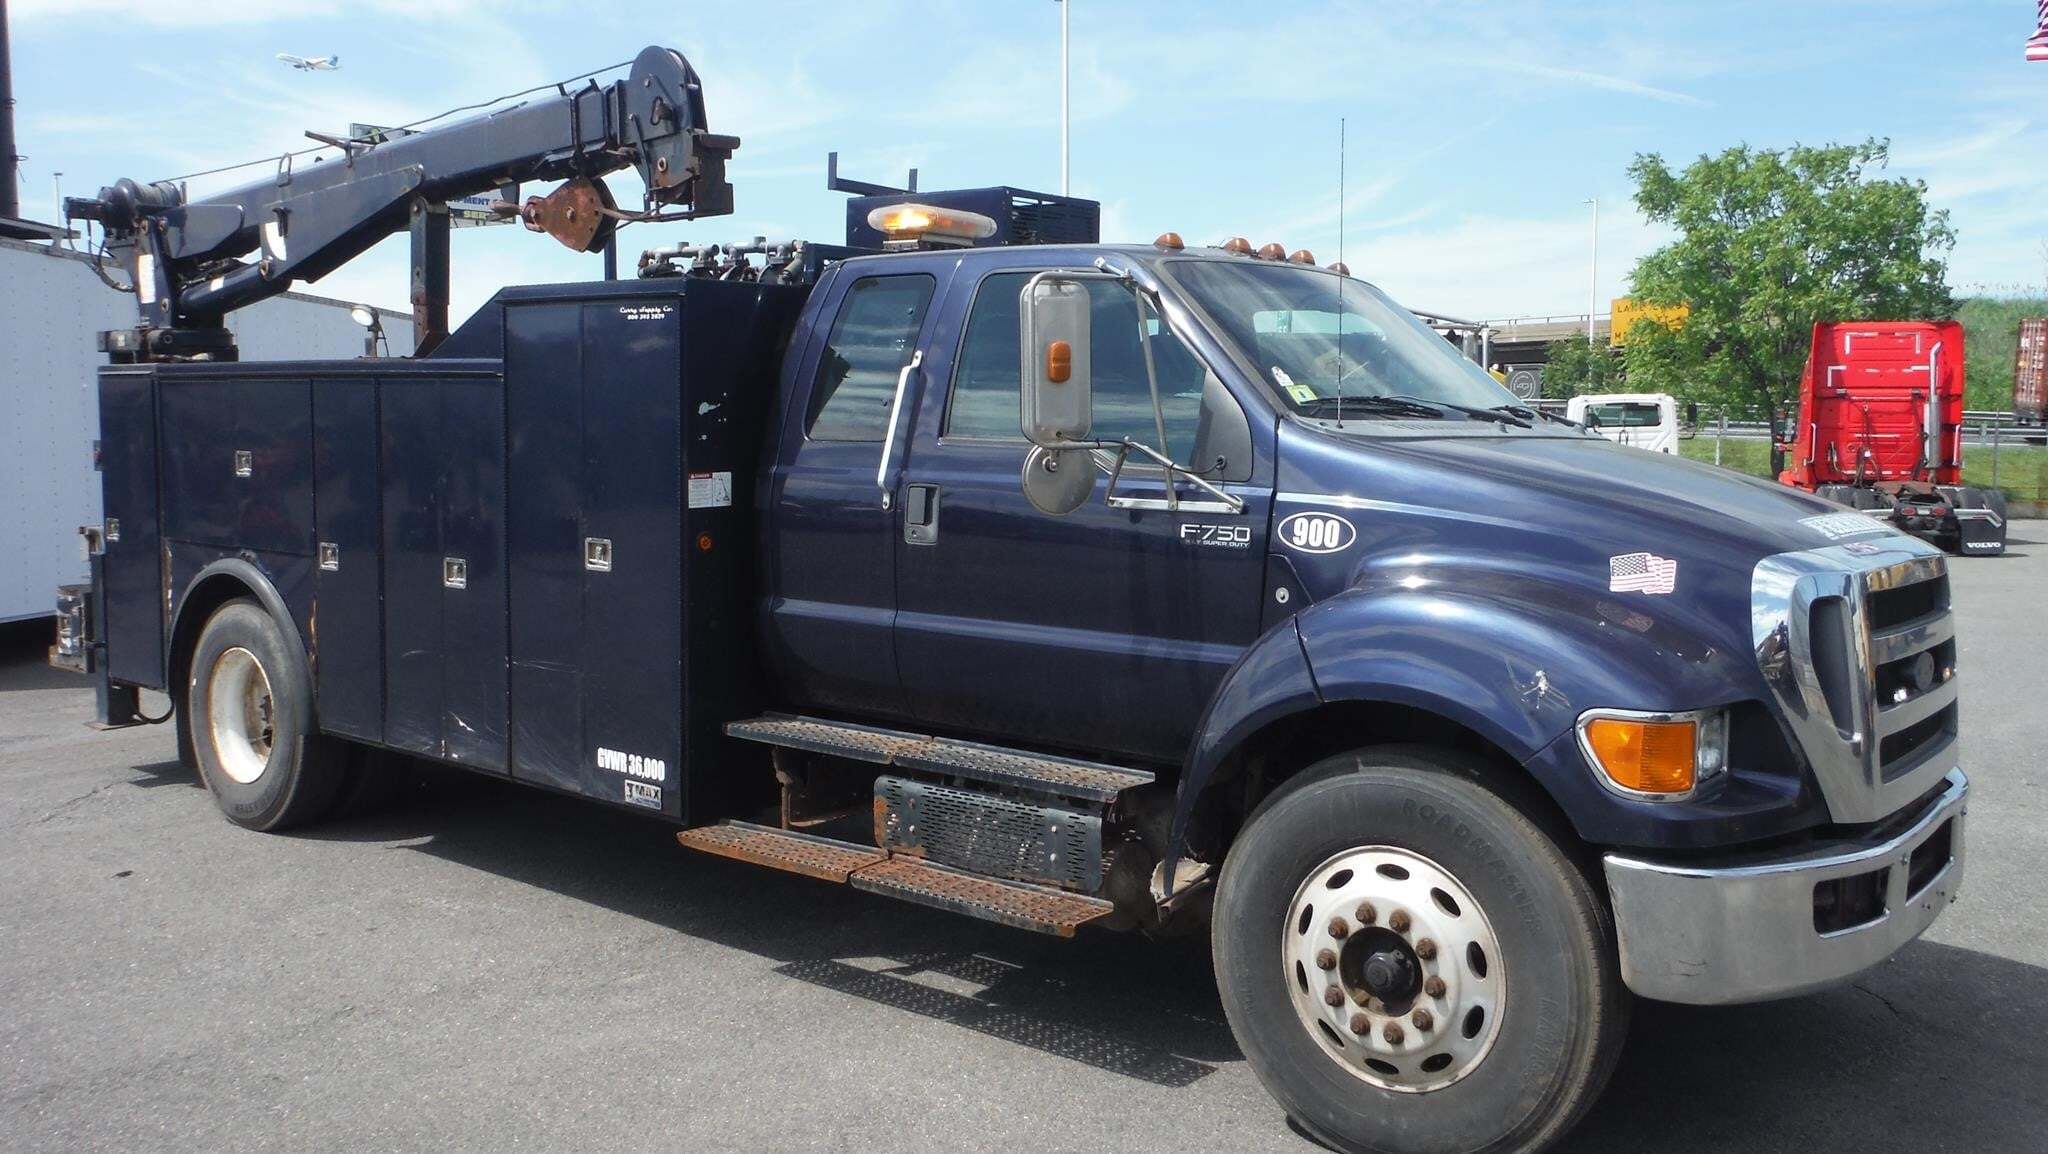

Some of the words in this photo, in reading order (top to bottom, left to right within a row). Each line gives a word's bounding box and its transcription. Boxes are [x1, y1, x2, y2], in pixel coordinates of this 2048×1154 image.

[1228, 541, 1250, 549] DUTY
[1292, 517, 1340, 548] 900
[598, 747, 627, 773] GVWR
[628, 754, 665, 781] 36,000
